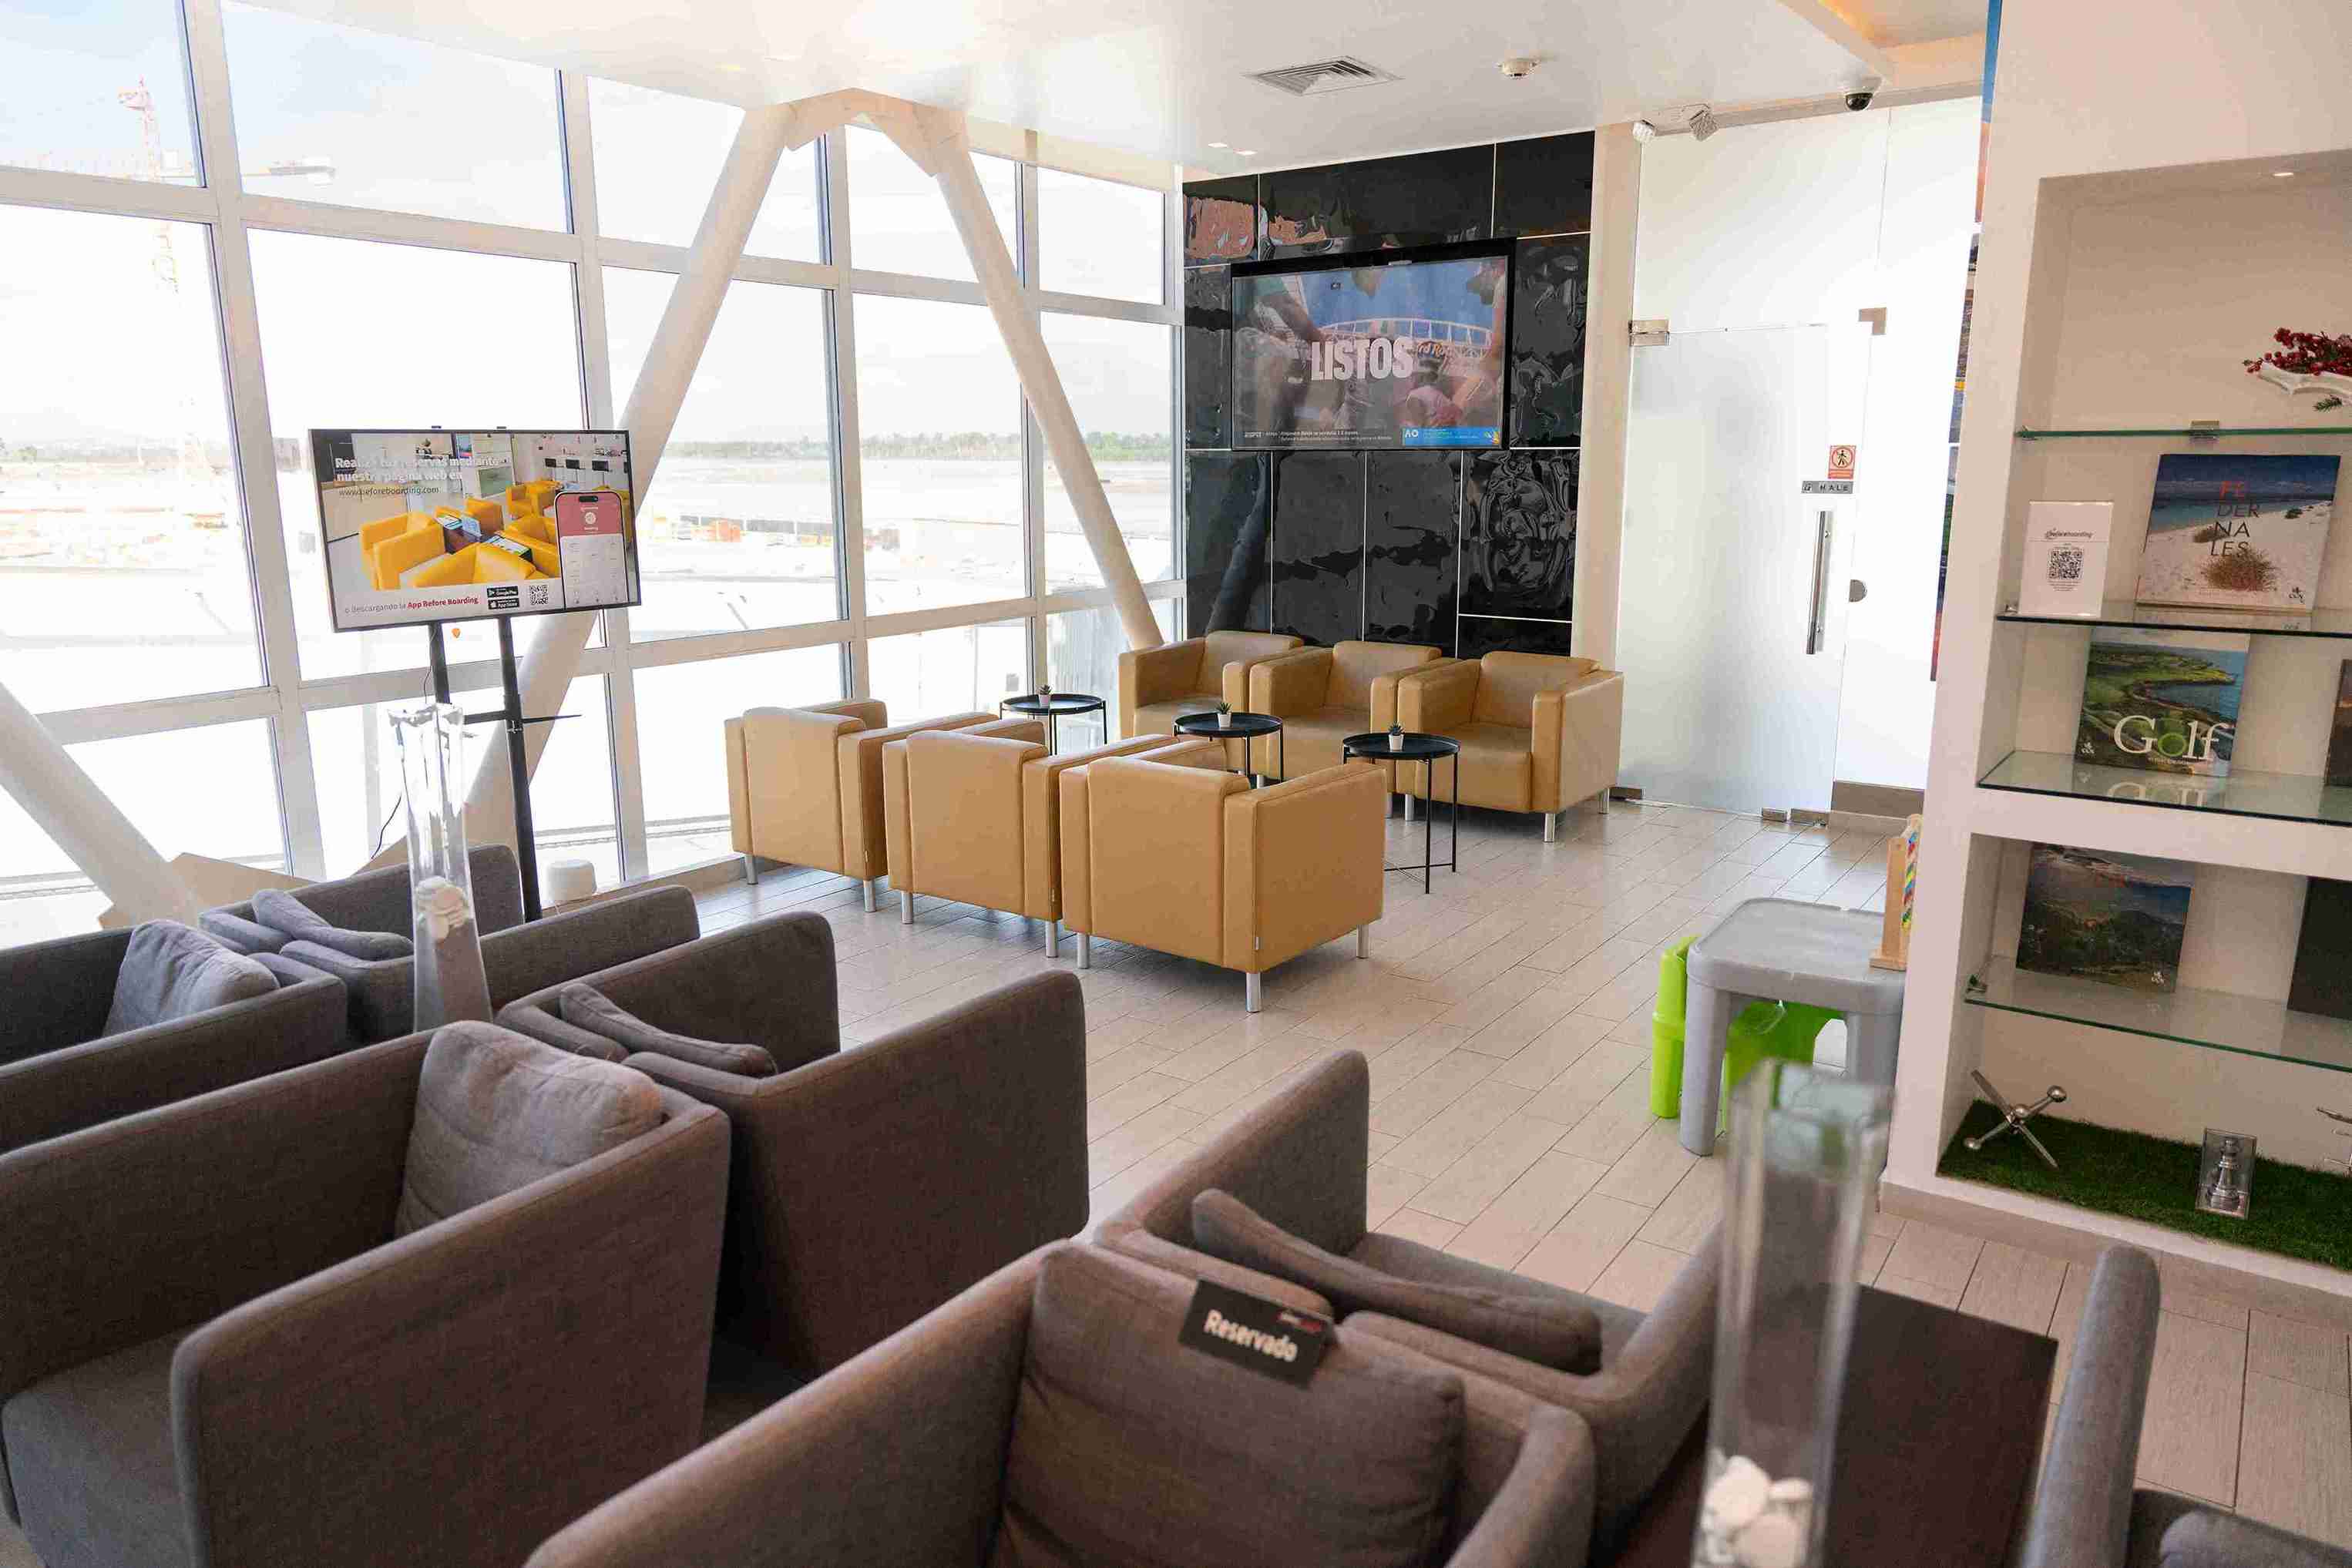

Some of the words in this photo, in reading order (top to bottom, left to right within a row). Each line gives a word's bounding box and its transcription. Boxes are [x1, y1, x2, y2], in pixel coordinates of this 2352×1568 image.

[1311, 337, 1414, 381] LISTOS
[2214, 521, 2250, 538] NA
[2210, 539, 2250, 558] LES
[407, 601, 422, 609] App
[422, 599, 446, 607] Before
[448, 596, 479, 606] Boarding
[2114, 714, 2229, 761] Golf
